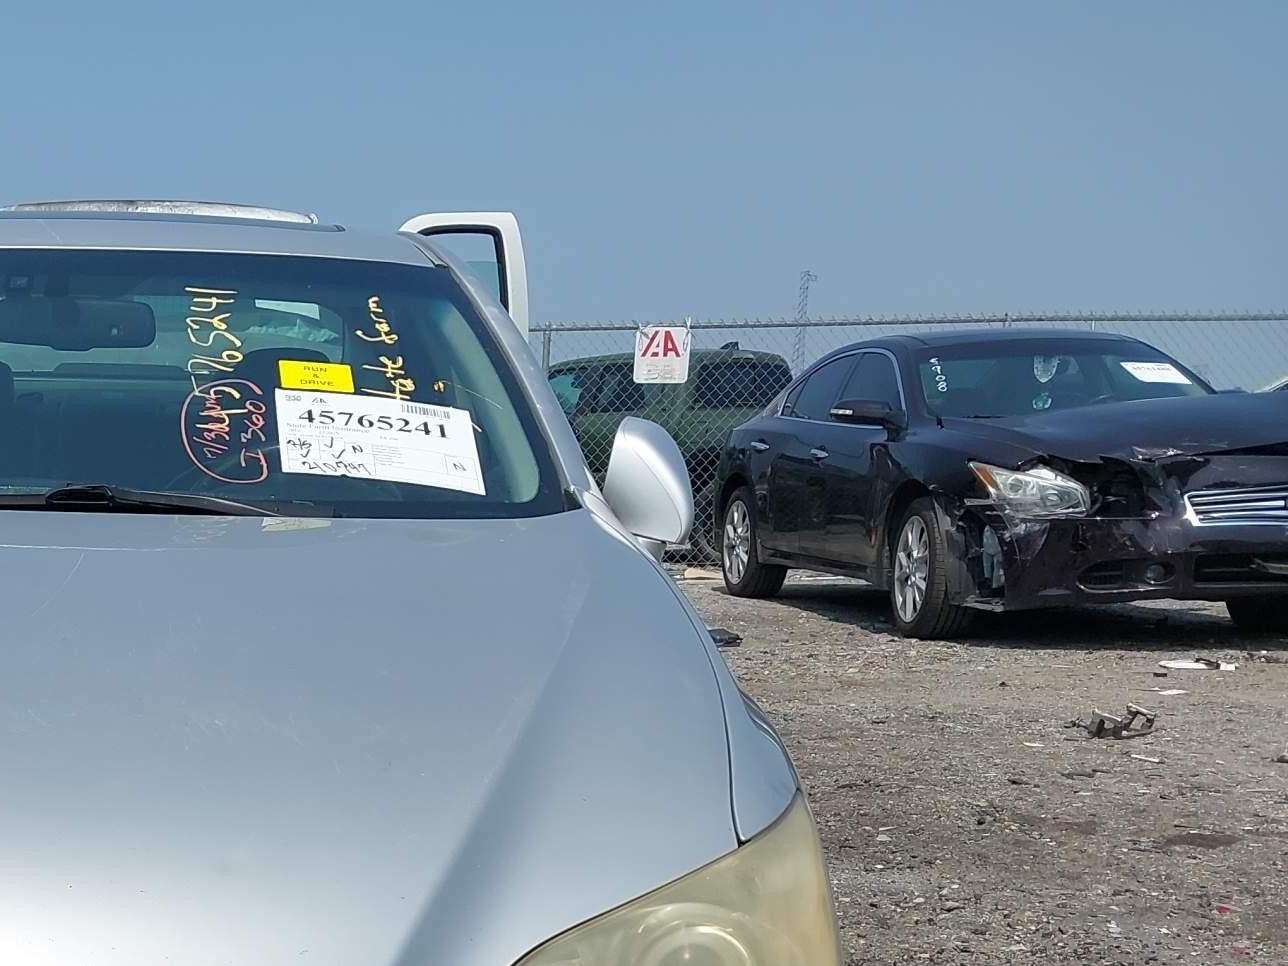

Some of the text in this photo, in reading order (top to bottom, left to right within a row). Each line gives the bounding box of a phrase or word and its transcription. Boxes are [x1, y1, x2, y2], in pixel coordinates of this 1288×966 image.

[300, 379, 335, 387] DRIVE
[360, 355, 415, 400] tate
[298, 409, 449, 439] 45765241
